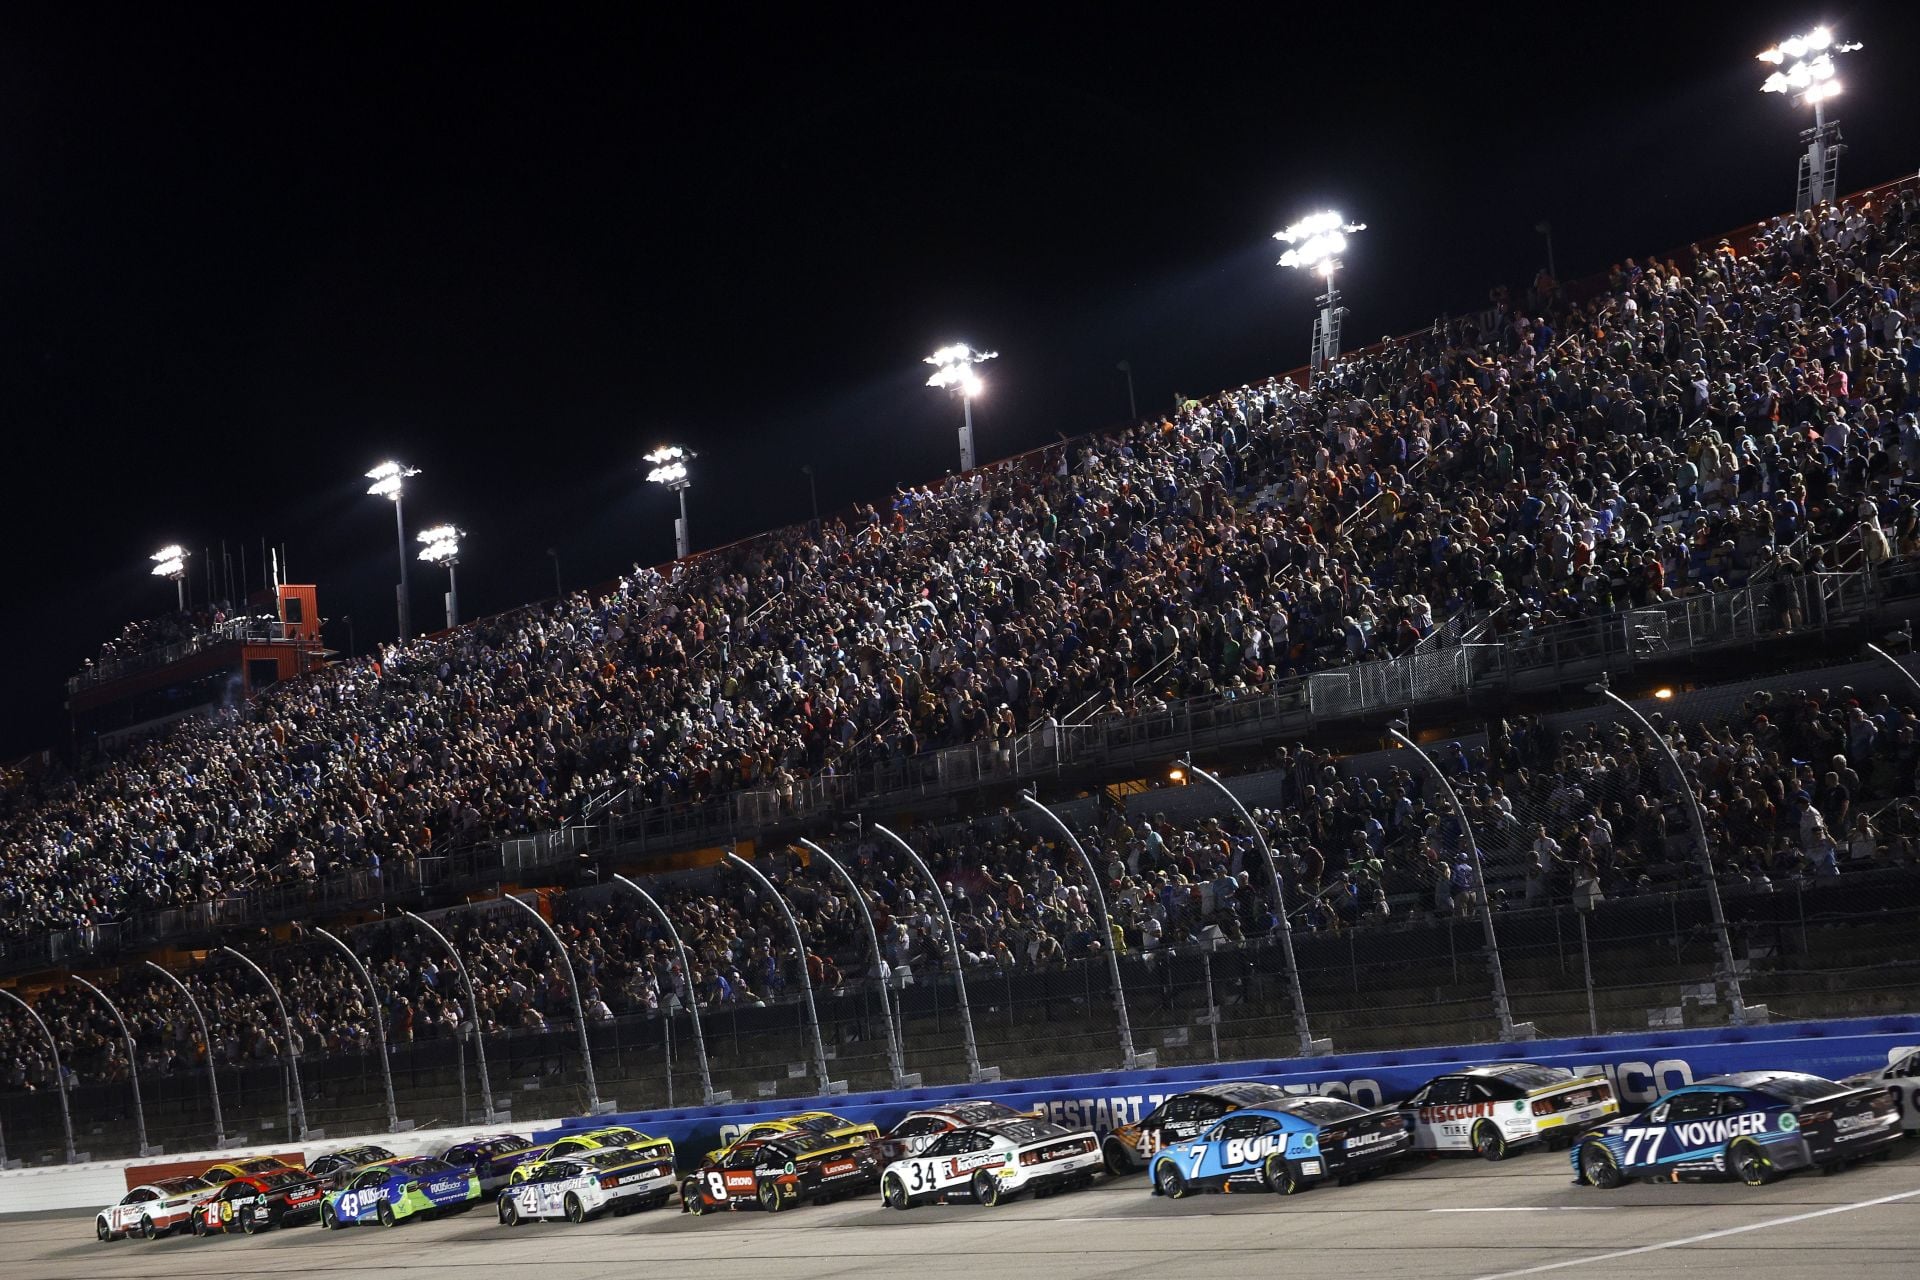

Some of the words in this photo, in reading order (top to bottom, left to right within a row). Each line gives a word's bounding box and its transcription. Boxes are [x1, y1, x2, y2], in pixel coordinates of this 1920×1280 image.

[1418, 1101, 1496, 1125] DISCOUNT
[1443, 1125, 1468, 1136] TIRE
[1673, 1112, 1767, 1147] VOYAGER
[1135, 1128, 1162, 1159] 41
[1622, 1126, 1668, 1166] 77
[824, 1163, 853, 1174] Lenovo
[1189, 1144, 1208, 1179] 7
[707, 1171, 728, 1200] 8
[726, 1175, 752, 1186] Lenovo
[910, 1161, 937, 1191] 34
[208, 1202, 219, 1224] 19
[298, 1199, 321, 1209] TOYOTA
[341, 1193, 359, 1217] 43
[522, 1190, 538, 1218] 4
[112, 1208, 122, 1229] 11
